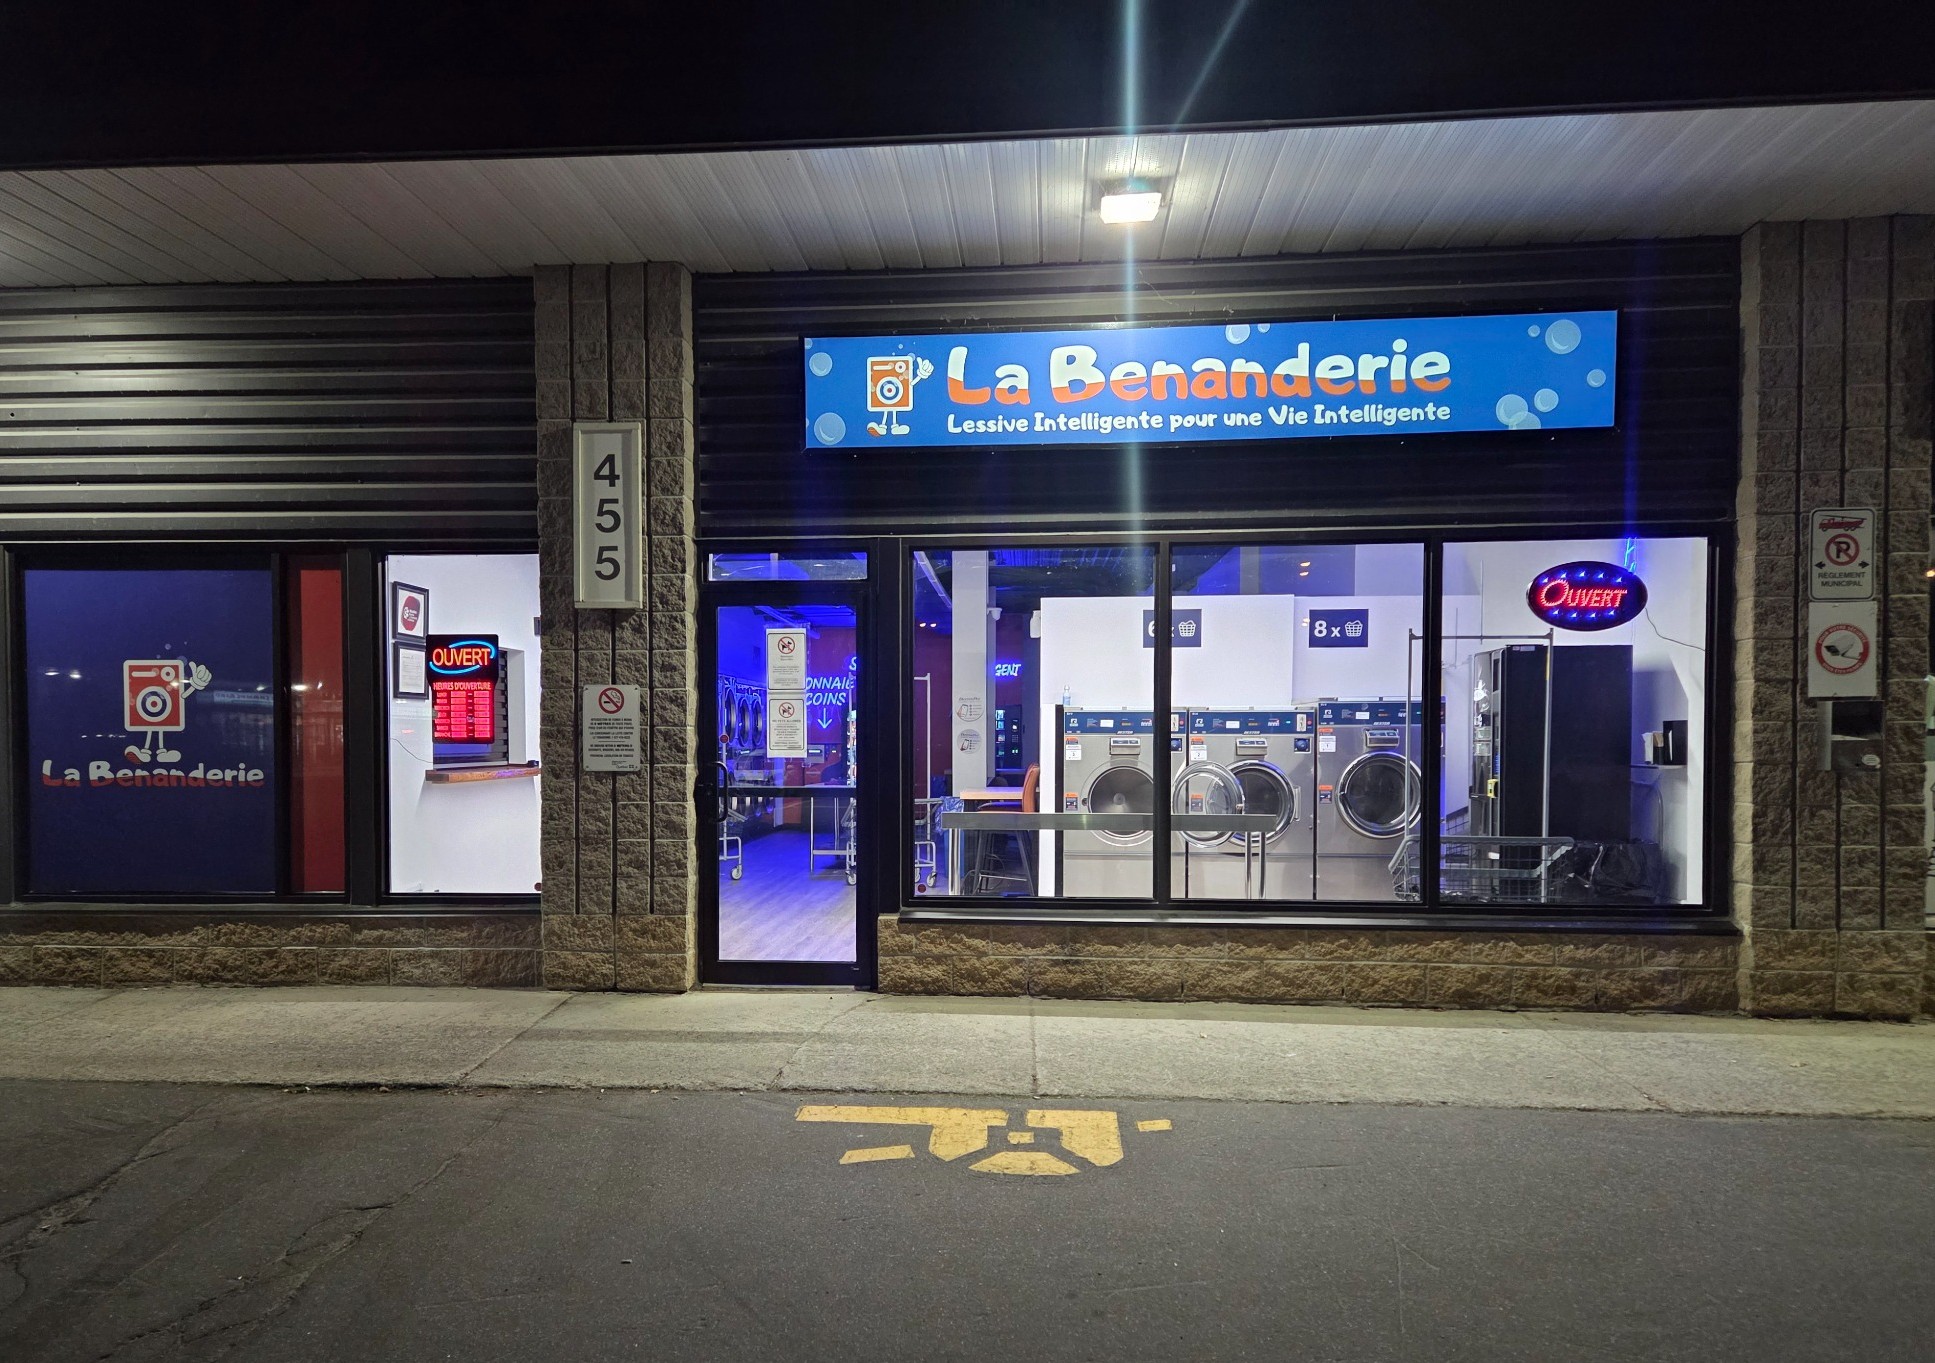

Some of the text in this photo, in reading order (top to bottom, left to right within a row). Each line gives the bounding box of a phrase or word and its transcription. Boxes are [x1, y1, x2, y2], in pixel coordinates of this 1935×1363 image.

[947, 338, 1451, 405] La Benanderie
[947, 402, 1451, 434] Lessive Intelligente pour une Vie Intelligente
[593, 453, 622, 581] 455
[1314, 620, 1341, 637] 8 x
[432, 648, 491, 666] OUVERT
[433, 682, 454, 691] HEURES
[42, 759, 264, 788] La Benanderie
